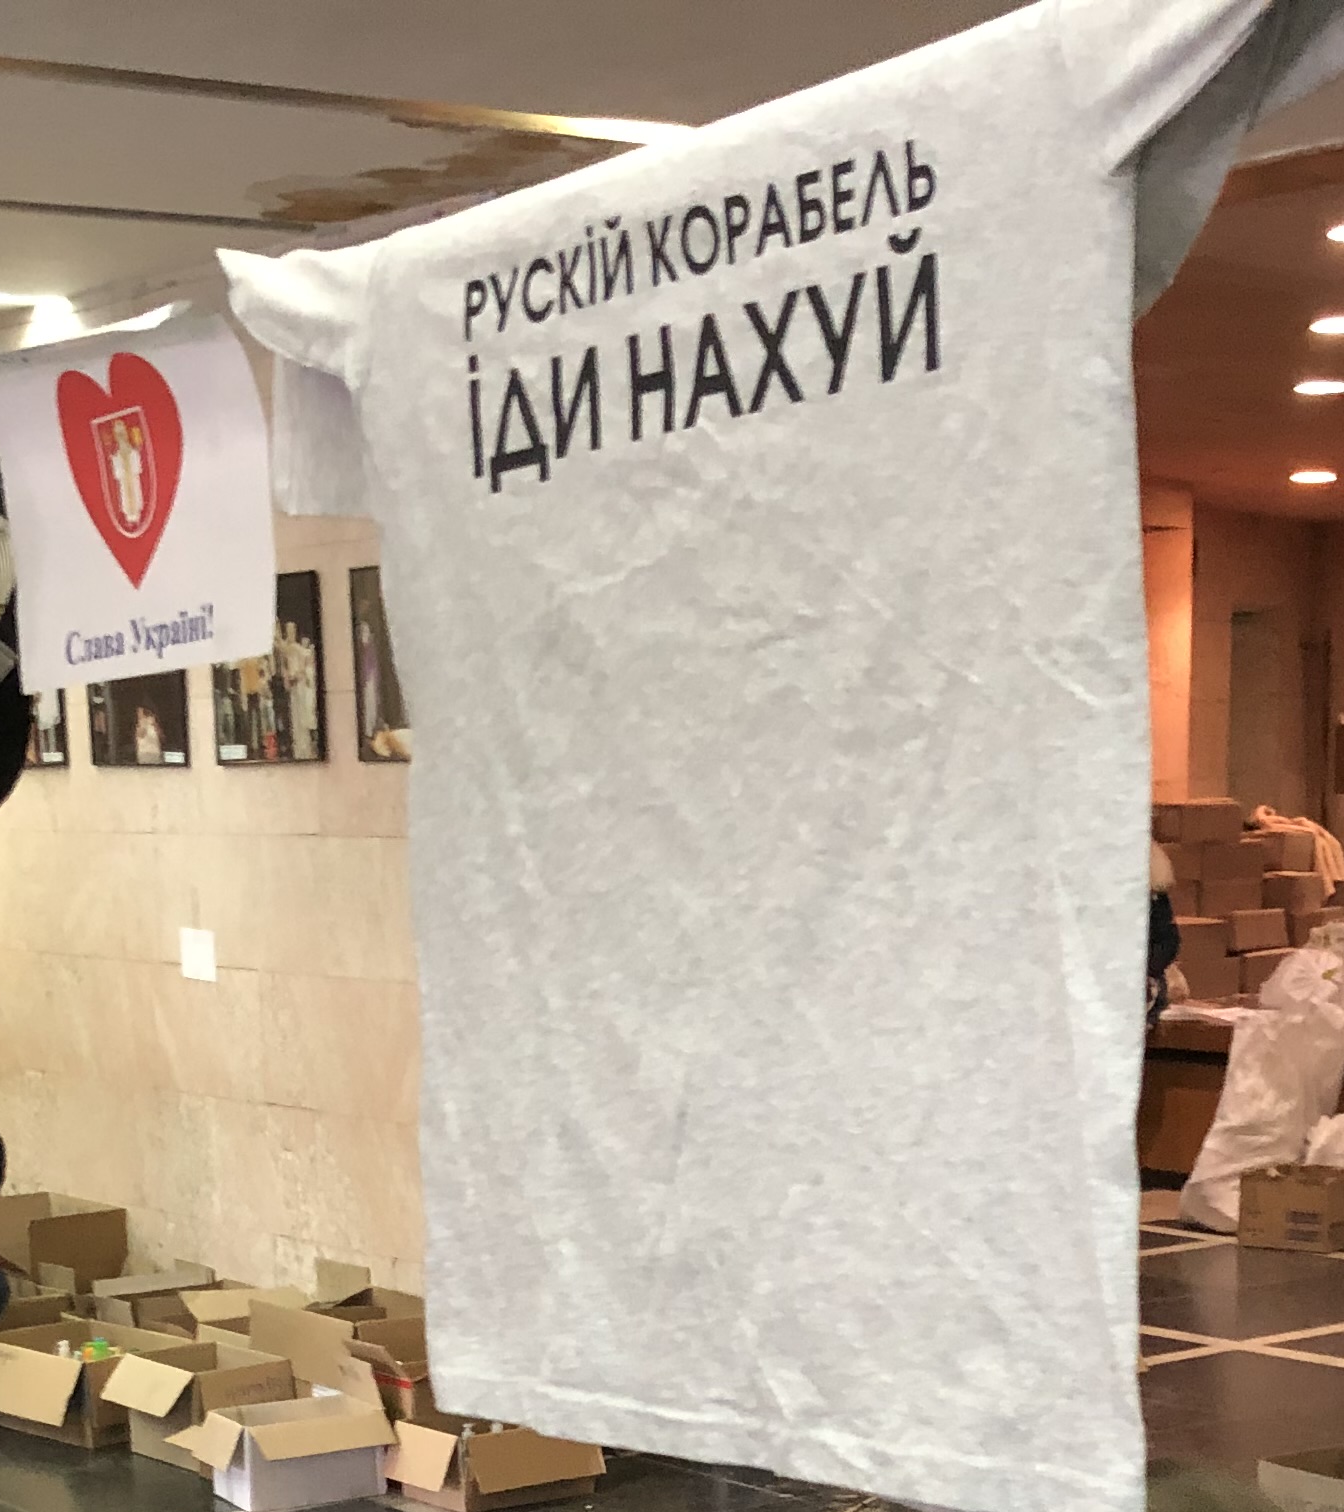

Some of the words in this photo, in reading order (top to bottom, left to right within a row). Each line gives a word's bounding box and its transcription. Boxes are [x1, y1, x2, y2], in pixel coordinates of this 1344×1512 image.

[463, 215, 634, 341] РУСКІЙ
[646, 139, 937, 288] КОРАБЕЛЬ
[626, 226, 941, 441] НАХУЙ
[65, 631, 126, 666] Слава
[129, 602, 214, 660] Україні!
